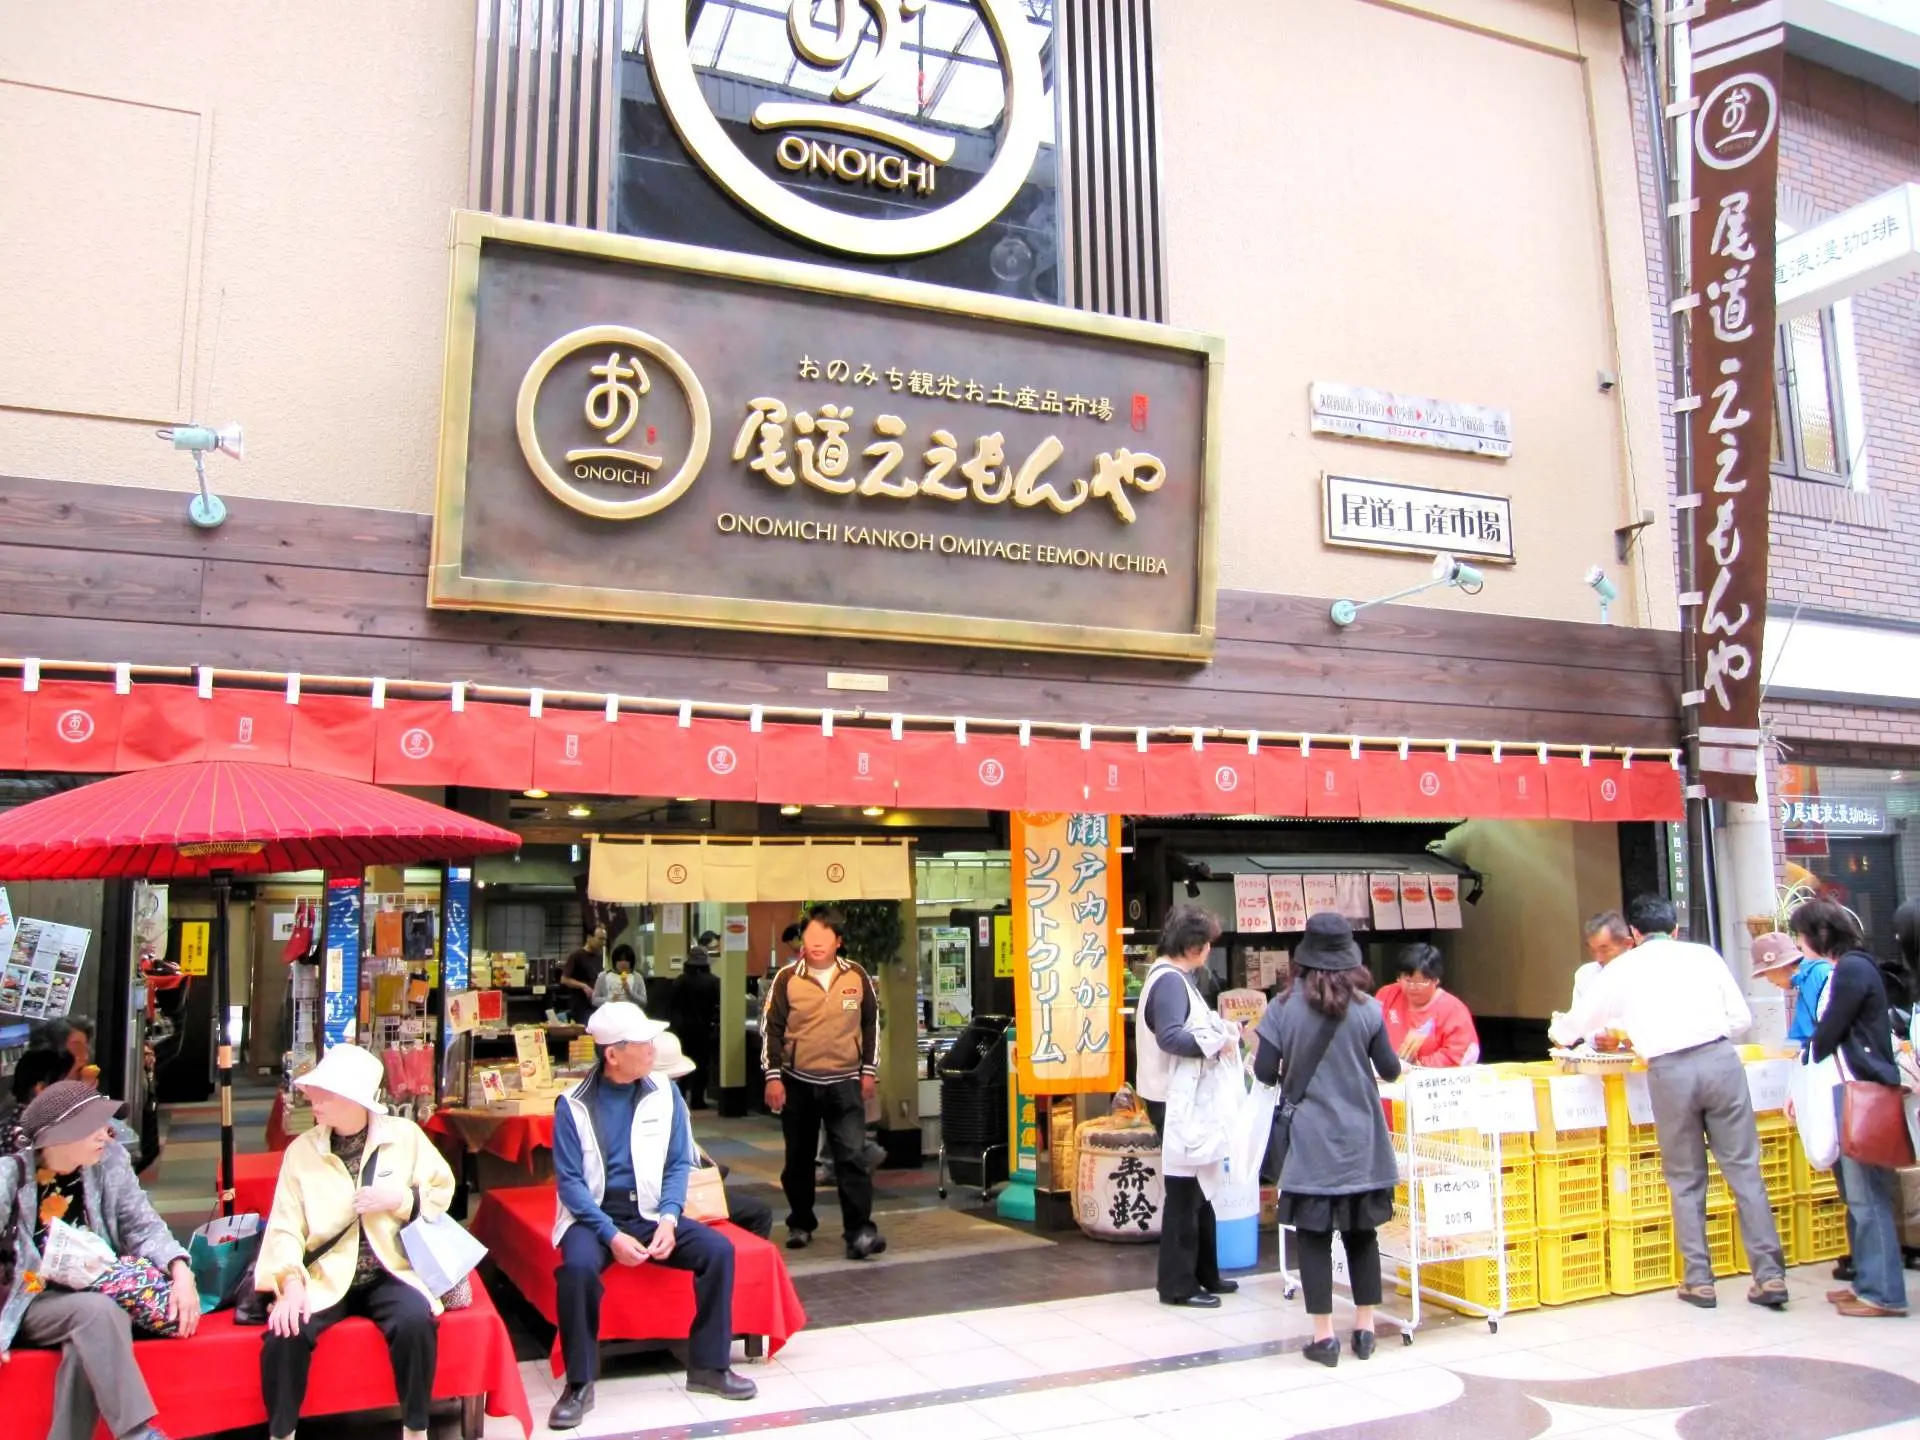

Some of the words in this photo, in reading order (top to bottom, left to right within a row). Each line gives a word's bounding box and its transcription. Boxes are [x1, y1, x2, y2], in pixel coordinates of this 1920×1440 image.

[777, 136, 936, 197] ONOICHI
[799, 354, 1116, 421] おのみち観光お土産品市場
[574, 464, 651, 485] ONOICHI
[732, 396, 1168, 524] 尾道ええもんや
[1703, 190, 1757, 712] 尾道ええもんや
[716, 512, 838, 542] ONOMICHI
[843, 524, 934, 551] KANKOH
[939, 534, 1032, 561] OMIYAGE
[1036, 544, 1104, 569] EEMON
[1107, 552, 1169, 576] ICHIBA
[1340, 492, 1502, 543] 尾道土産市場
[1792, 802, 1881, 827] 尾道浪漫珈琲
[1238, 896, 1268, 909] バニラ
[1024, 846, 1066, 1065] ソフトクリーム
